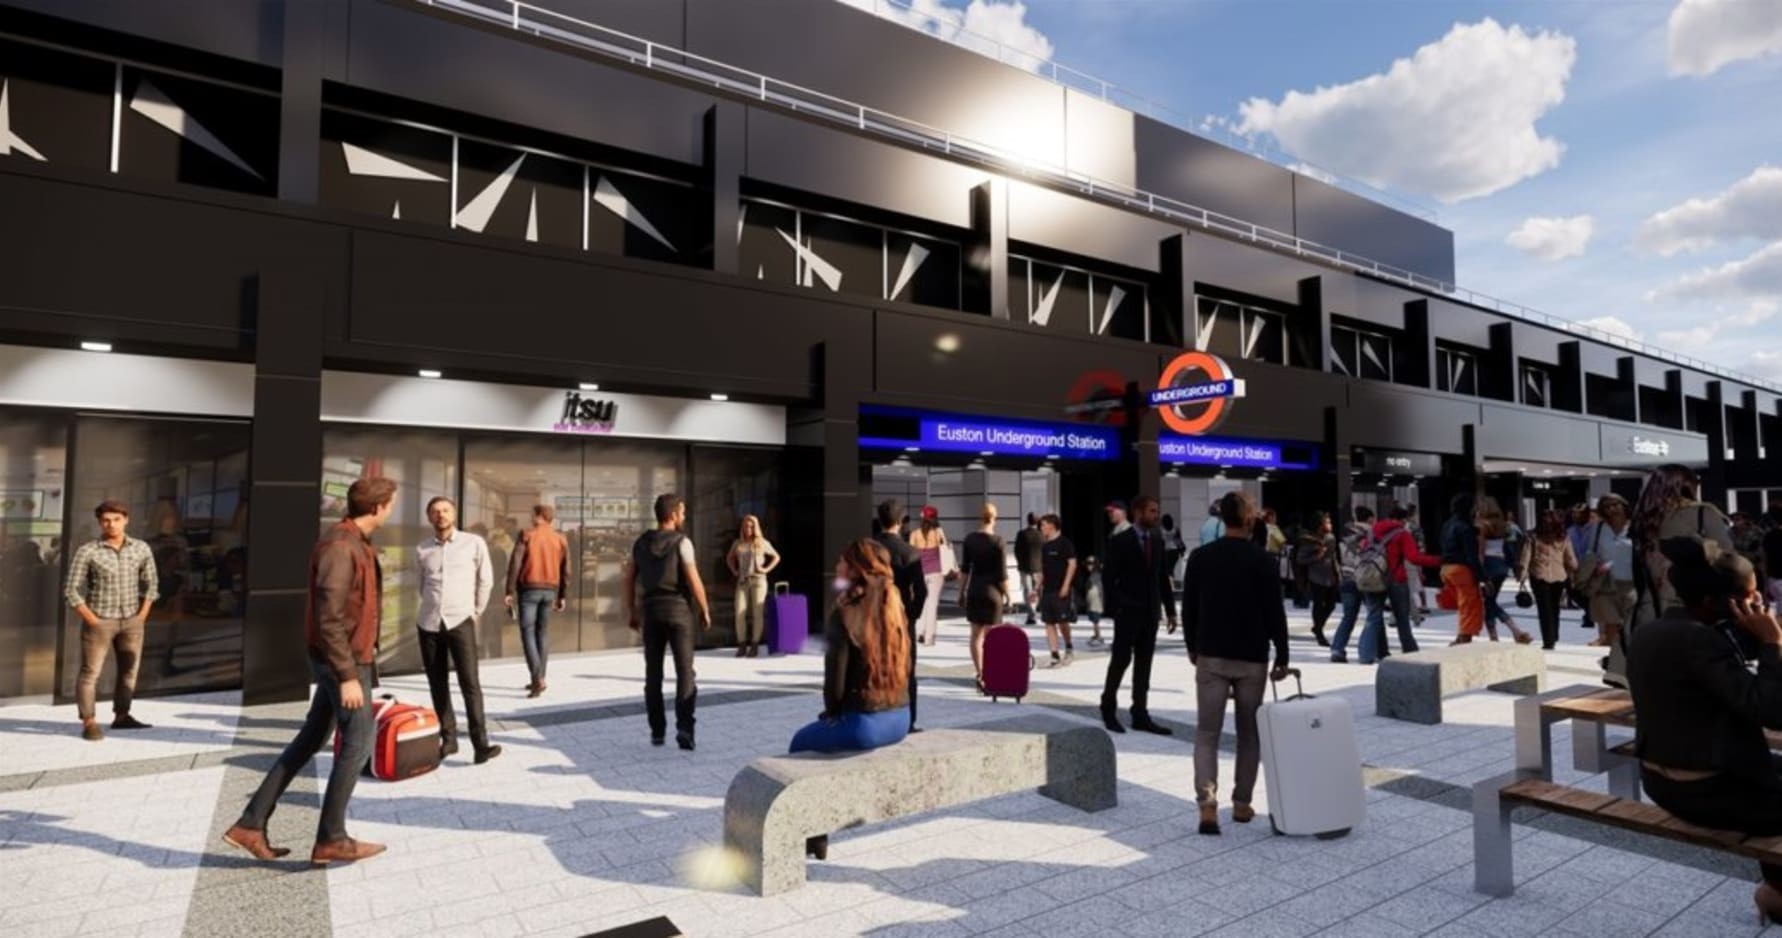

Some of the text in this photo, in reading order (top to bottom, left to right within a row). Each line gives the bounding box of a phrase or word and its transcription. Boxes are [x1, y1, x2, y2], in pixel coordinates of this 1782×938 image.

[1151, 382, 1228, 402] UNDERGROUND
[563, 391, 617, 422] itsu
[937, 424, 1106, 450] Euston Underground Station
[1159, 441, 1273, 460] uston Underground Station
